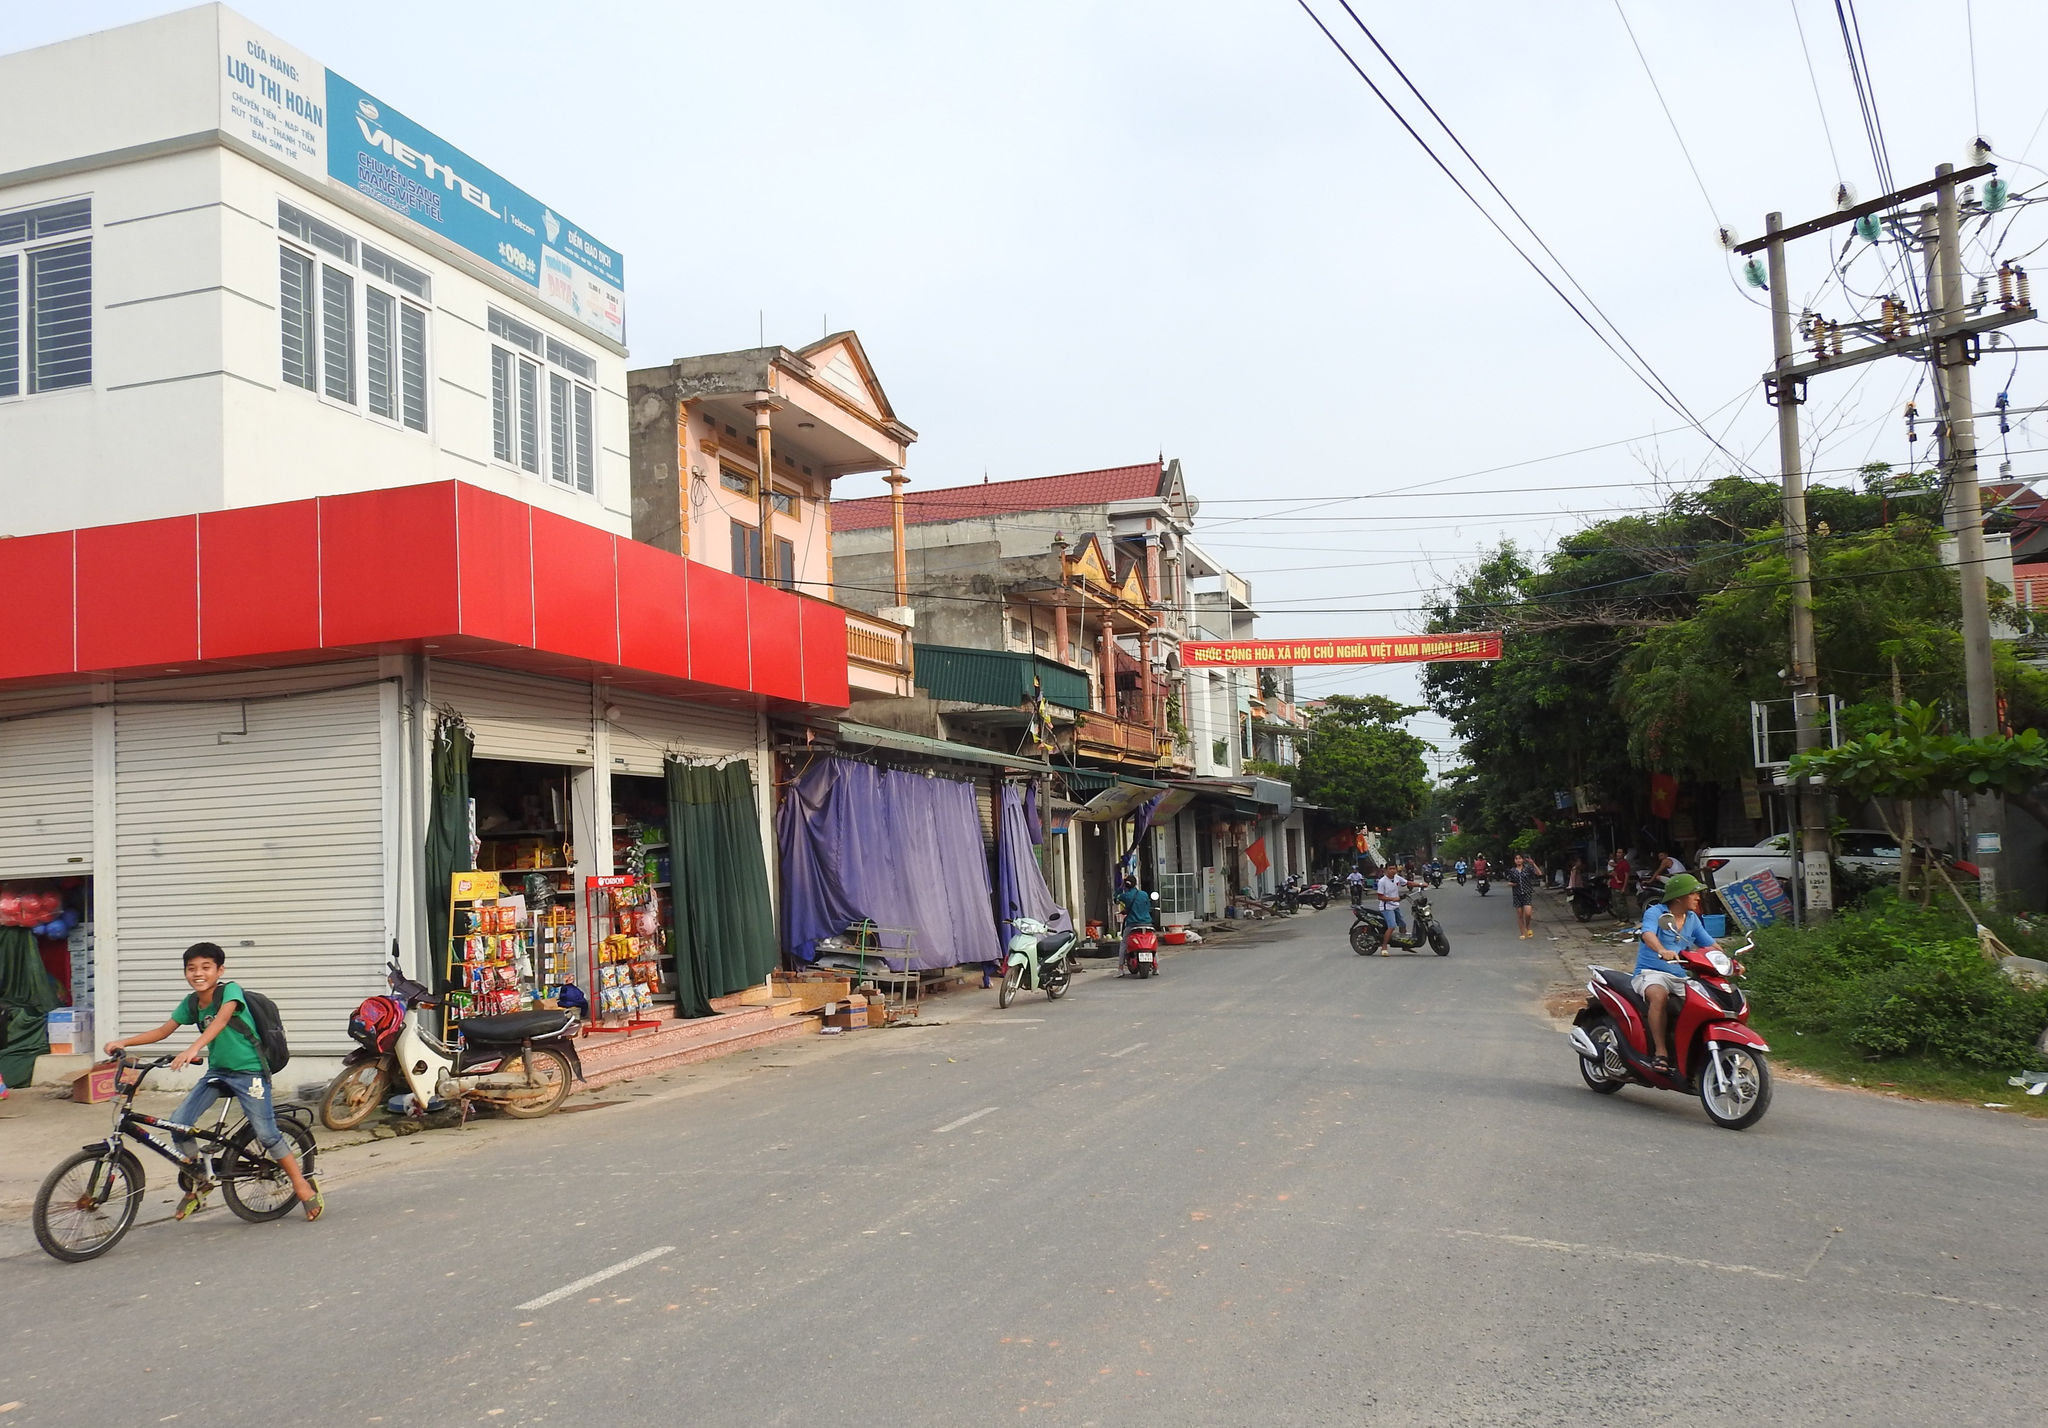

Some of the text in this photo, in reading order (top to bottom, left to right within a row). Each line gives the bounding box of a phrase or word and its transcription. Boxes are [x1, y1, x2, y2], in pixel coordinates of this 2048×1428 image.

[247, 40, 299, 82] CỬA HÀNG:
[227, 55, 323, 128] LƯU THỊ HOÀN
[269, 139, 283, 153] SIM
[396, 187, 445, 223] VIETTEL
[407, 179, 441, 207] SANG
[511, 214, 536, 237] Telecom
[1194, 646, 1222, 661] NƯỚC
[1224, 646, 1252, 663] CỘNG
[1277, 645, 1292, 660] XÃ
[1293, 644, 1311, 662] HỘI
[1313, 642, 1334, 659] CHỦ
[1336, 642, 1368, 658] NGHĨA
[1370, 641, 1393, 660] VIỆT
[1394, 643, 1419, 656] NAM
[1742, 883, 1773, 919] COPPY
